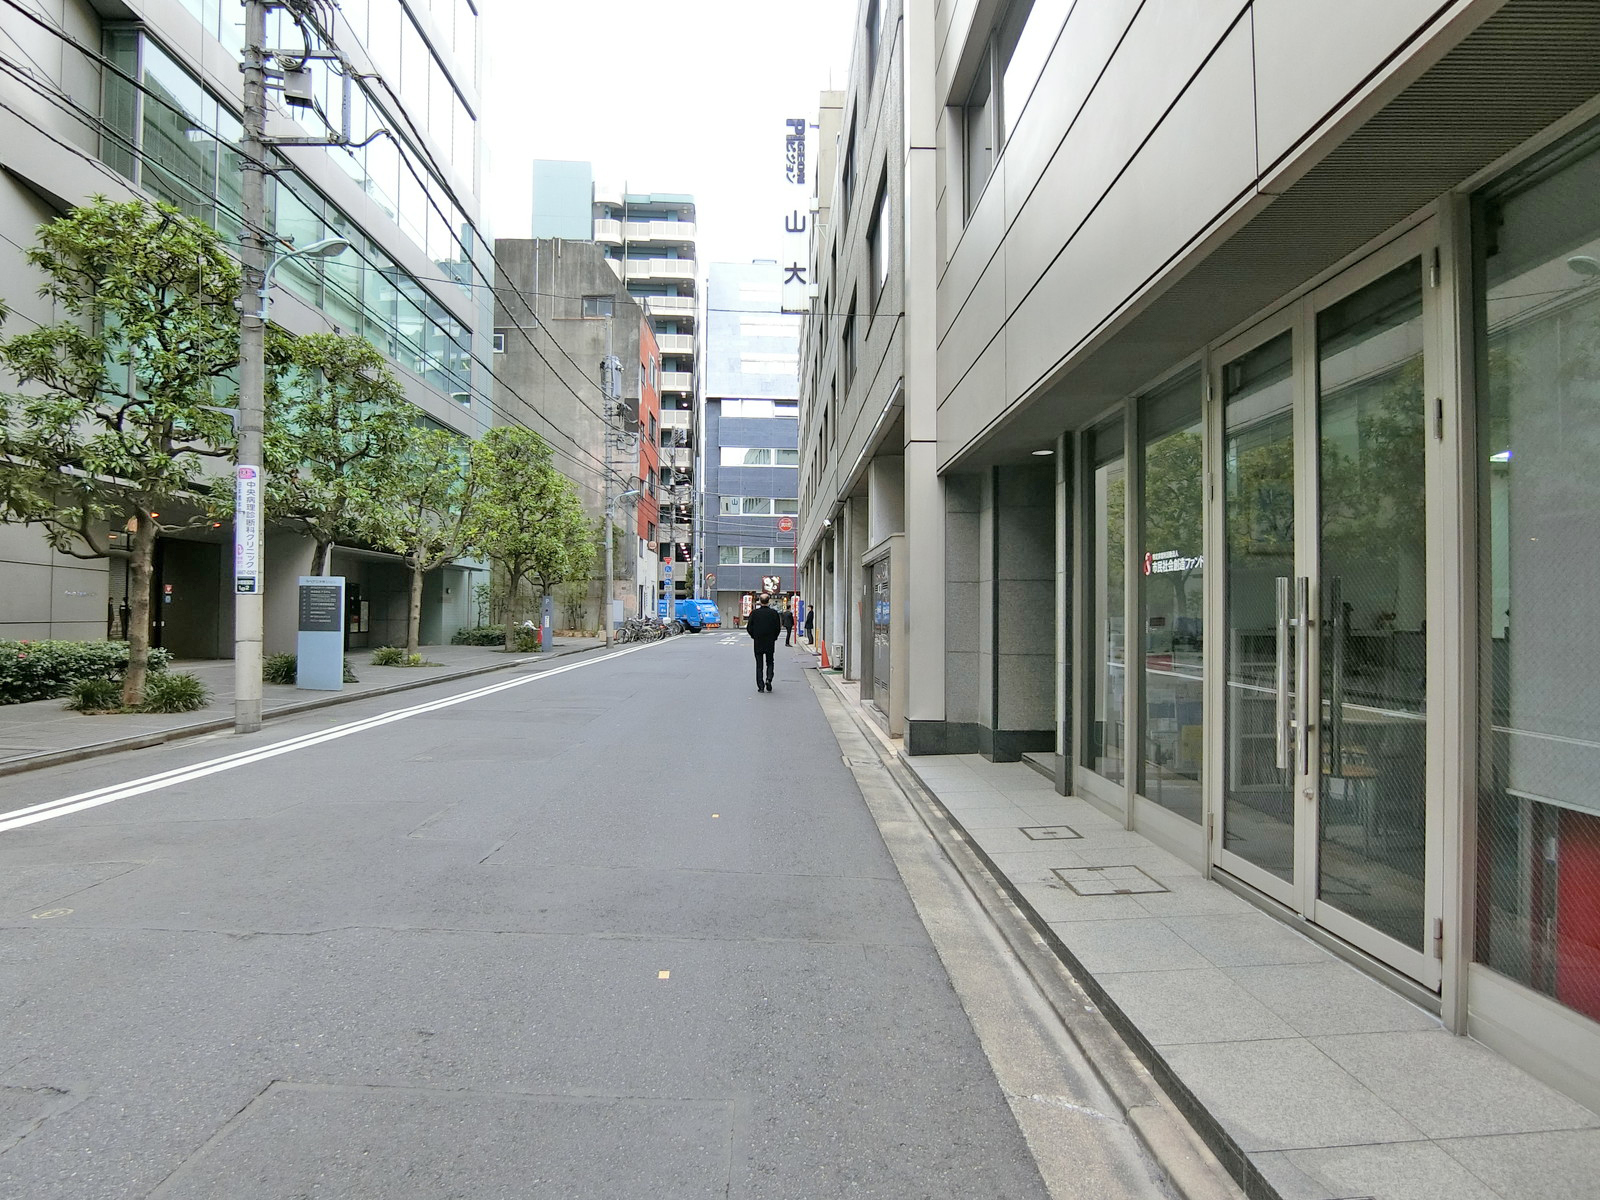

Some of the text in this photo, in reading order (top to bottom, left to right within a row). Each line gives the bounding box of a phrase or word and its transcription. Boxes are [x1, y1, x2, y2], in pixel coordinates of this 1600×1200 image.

[786, 118, 805, 184] PIGEON
[786, 142, 797, 184] ピジョン
[245, 481, 256, 567] 中央病理診断科クリニック
